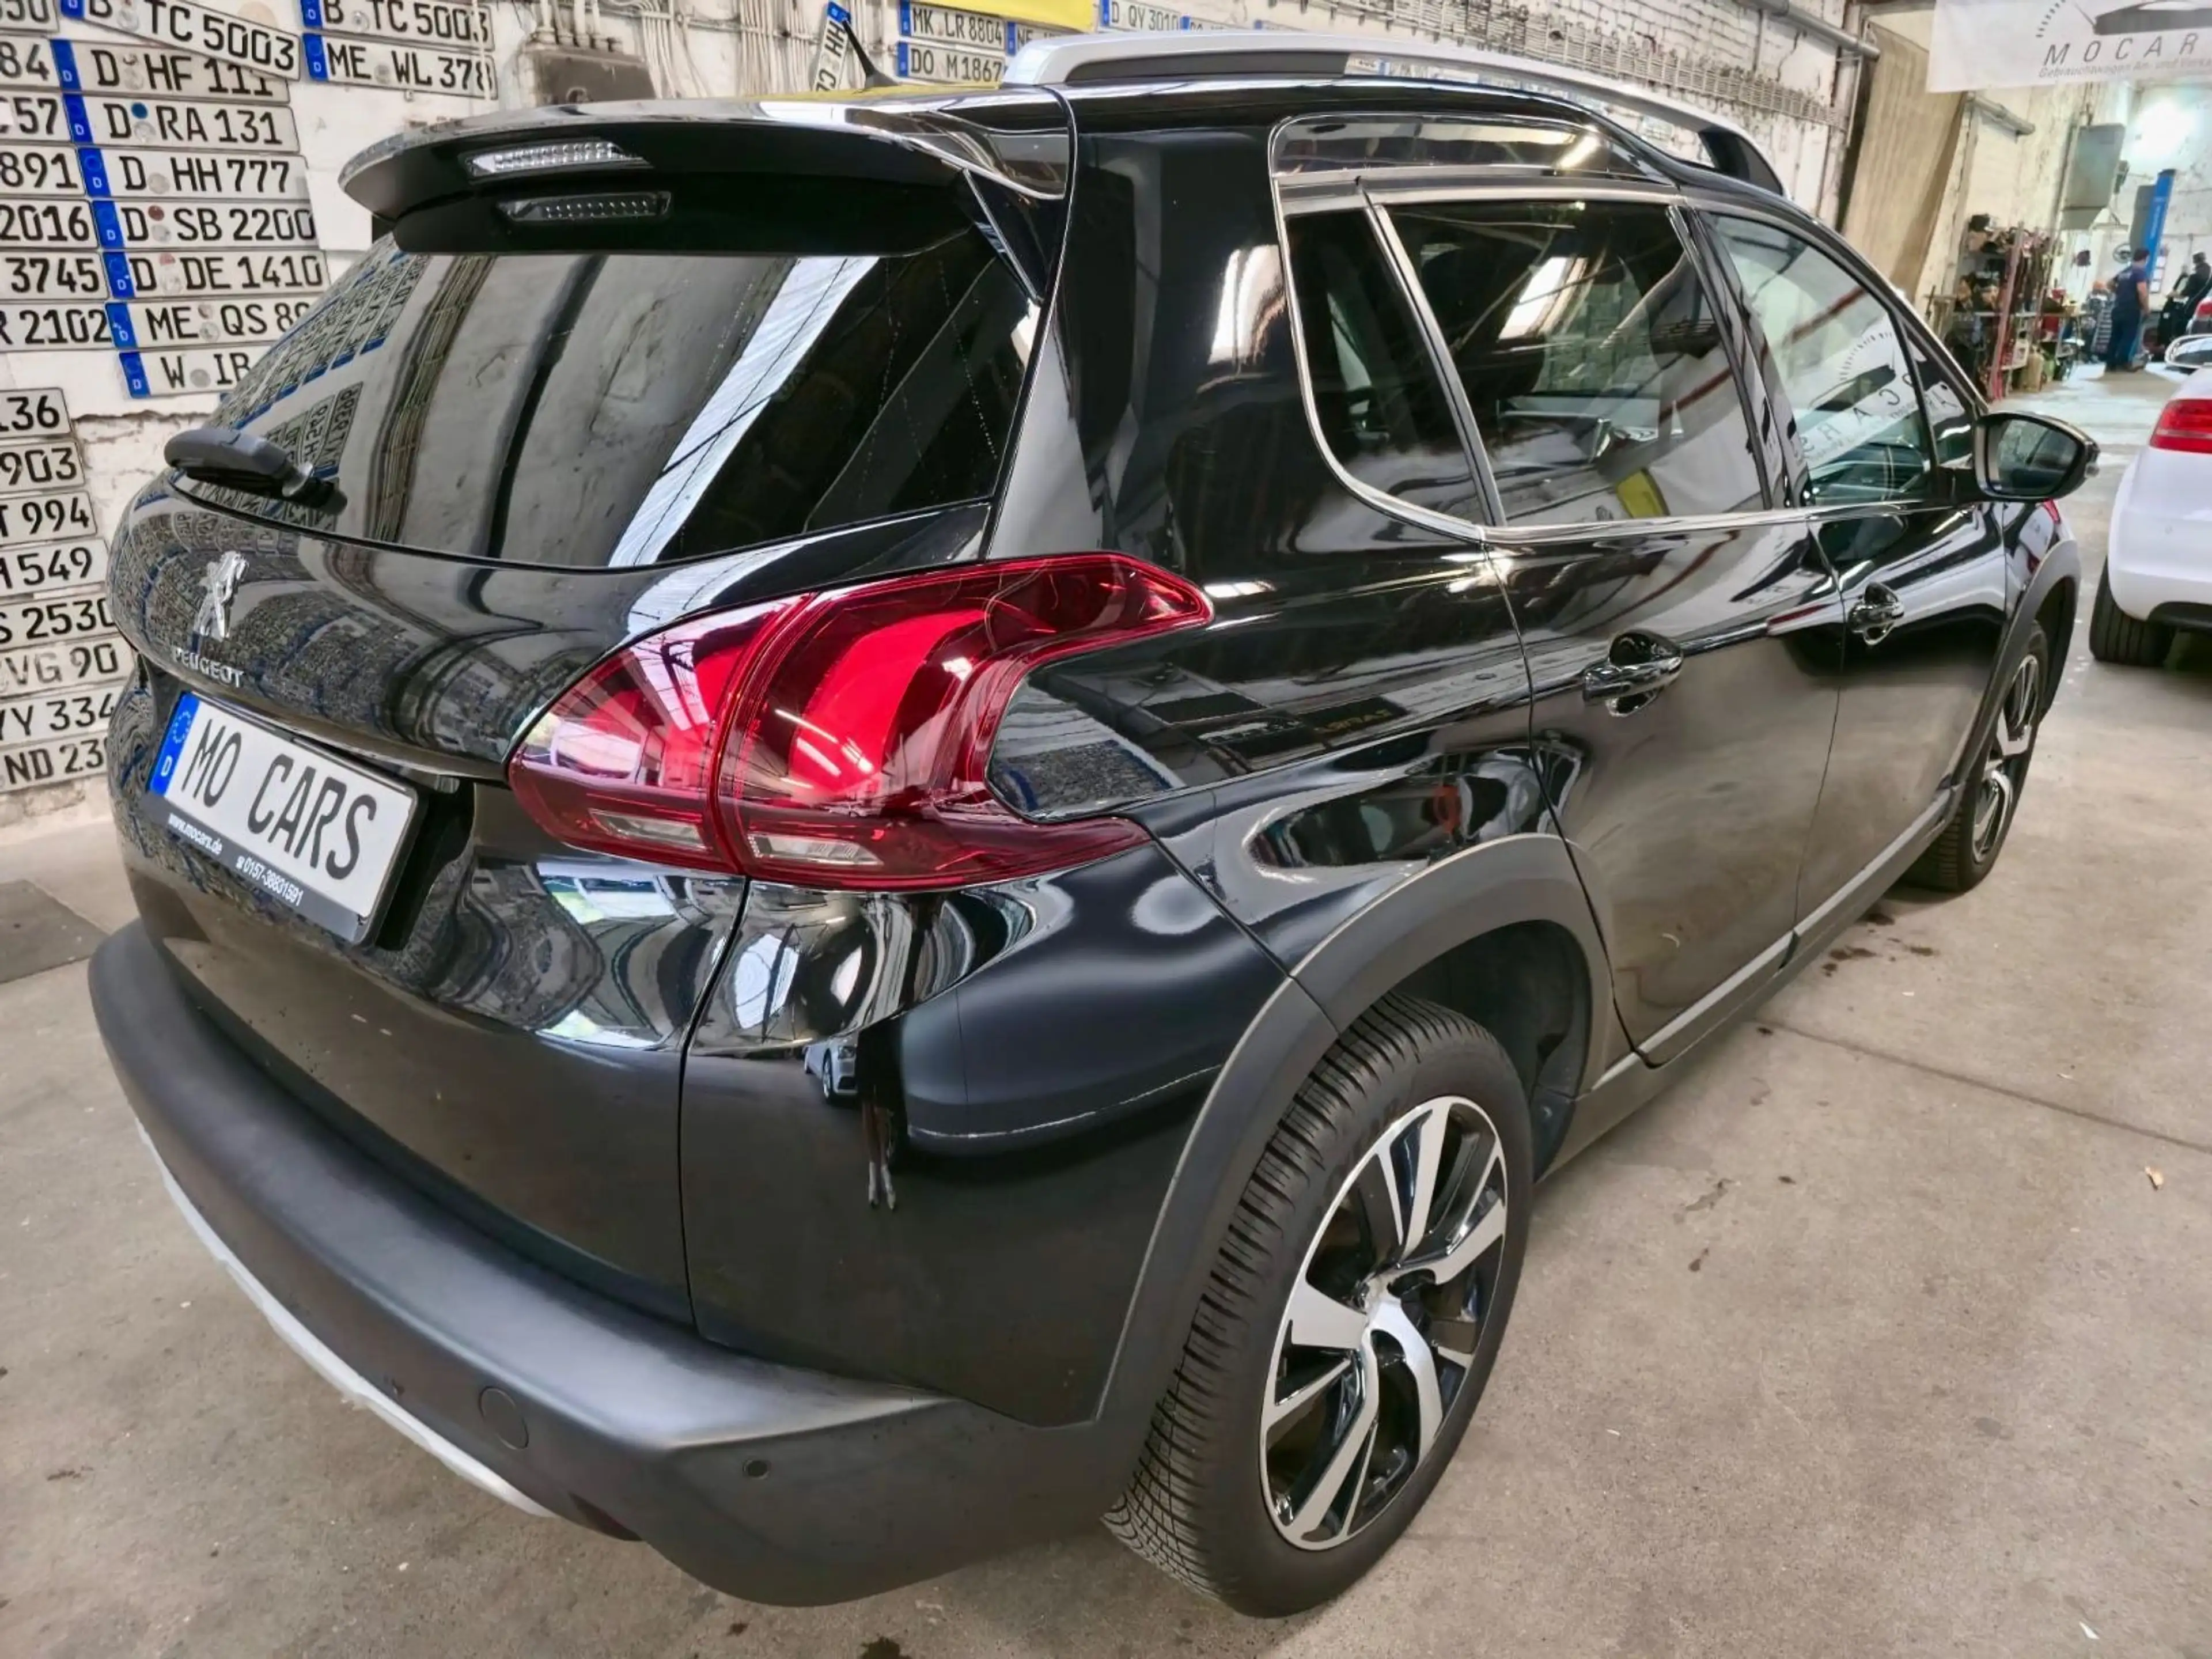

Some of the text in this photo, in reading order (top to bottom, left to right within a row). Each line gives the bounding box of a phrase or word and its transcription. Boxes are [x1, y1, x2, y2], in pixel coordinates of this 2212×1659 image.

[0, 0, 50, 23] 50
[324, 0, 344, 24] B
[371, 0, 407, 32] TC
[414, 3, 488, 43] 5003
[912, 7, 1002, 45] MK LR 8804
[1112, 2, 1119, 23] D
[1128, 5, 1146, 28] QY
[143, 0, 192, 41] TC
[203, 14, 294, 70] 5003
[824, 20, 846, 57] HH
[90, 50, 120, 86] D
[144, 54, 192, 90] HF
[203, 58, 273, 96] 111
[325, 42, 493, 92] ME WL 378
[911, 48, 1002, 82] DO M 1867
[103, 103, 131, 138] D
[156, 105, 209, 141] RA
[214, 109, 283, 145] 131
[0, 151, 78, 188] 891
[119, 156, 147, 190] D
[170, 157, 222, 192] HH
[226, 159, 290, 193] 777
[0, 204, 89, 241] 2016
[121, 207, 149, 241] D
[173, 207, 222, 241] SB
[229, 209, 316, 241] 2200
[5, 257, 100, 293] 3745
[129, 257, 157, 291] D
[180, 257, 232, 290] DE
[237, 255, 324, 289] 1410
[19, 309, 112, 344] 2102
[145, 306, 199, 340] ME
[220, 304, 268, 336] QS
[160, 355, 185, 389] W
[0, 447, 77, 486] 903
[21, 497, 89, 535] 994
[17, 547, 92, 586] 549
[5, 643, 119, 686] VG 90
[172, 645, 245, 688] PEUGEOT
[0, 694, 115, 741] Y 334
[4, 738, 109, 785] ND 23
[160, 718, 377, 881] D MO CARS
[168, 813, 223, 856] www.mocars.de
